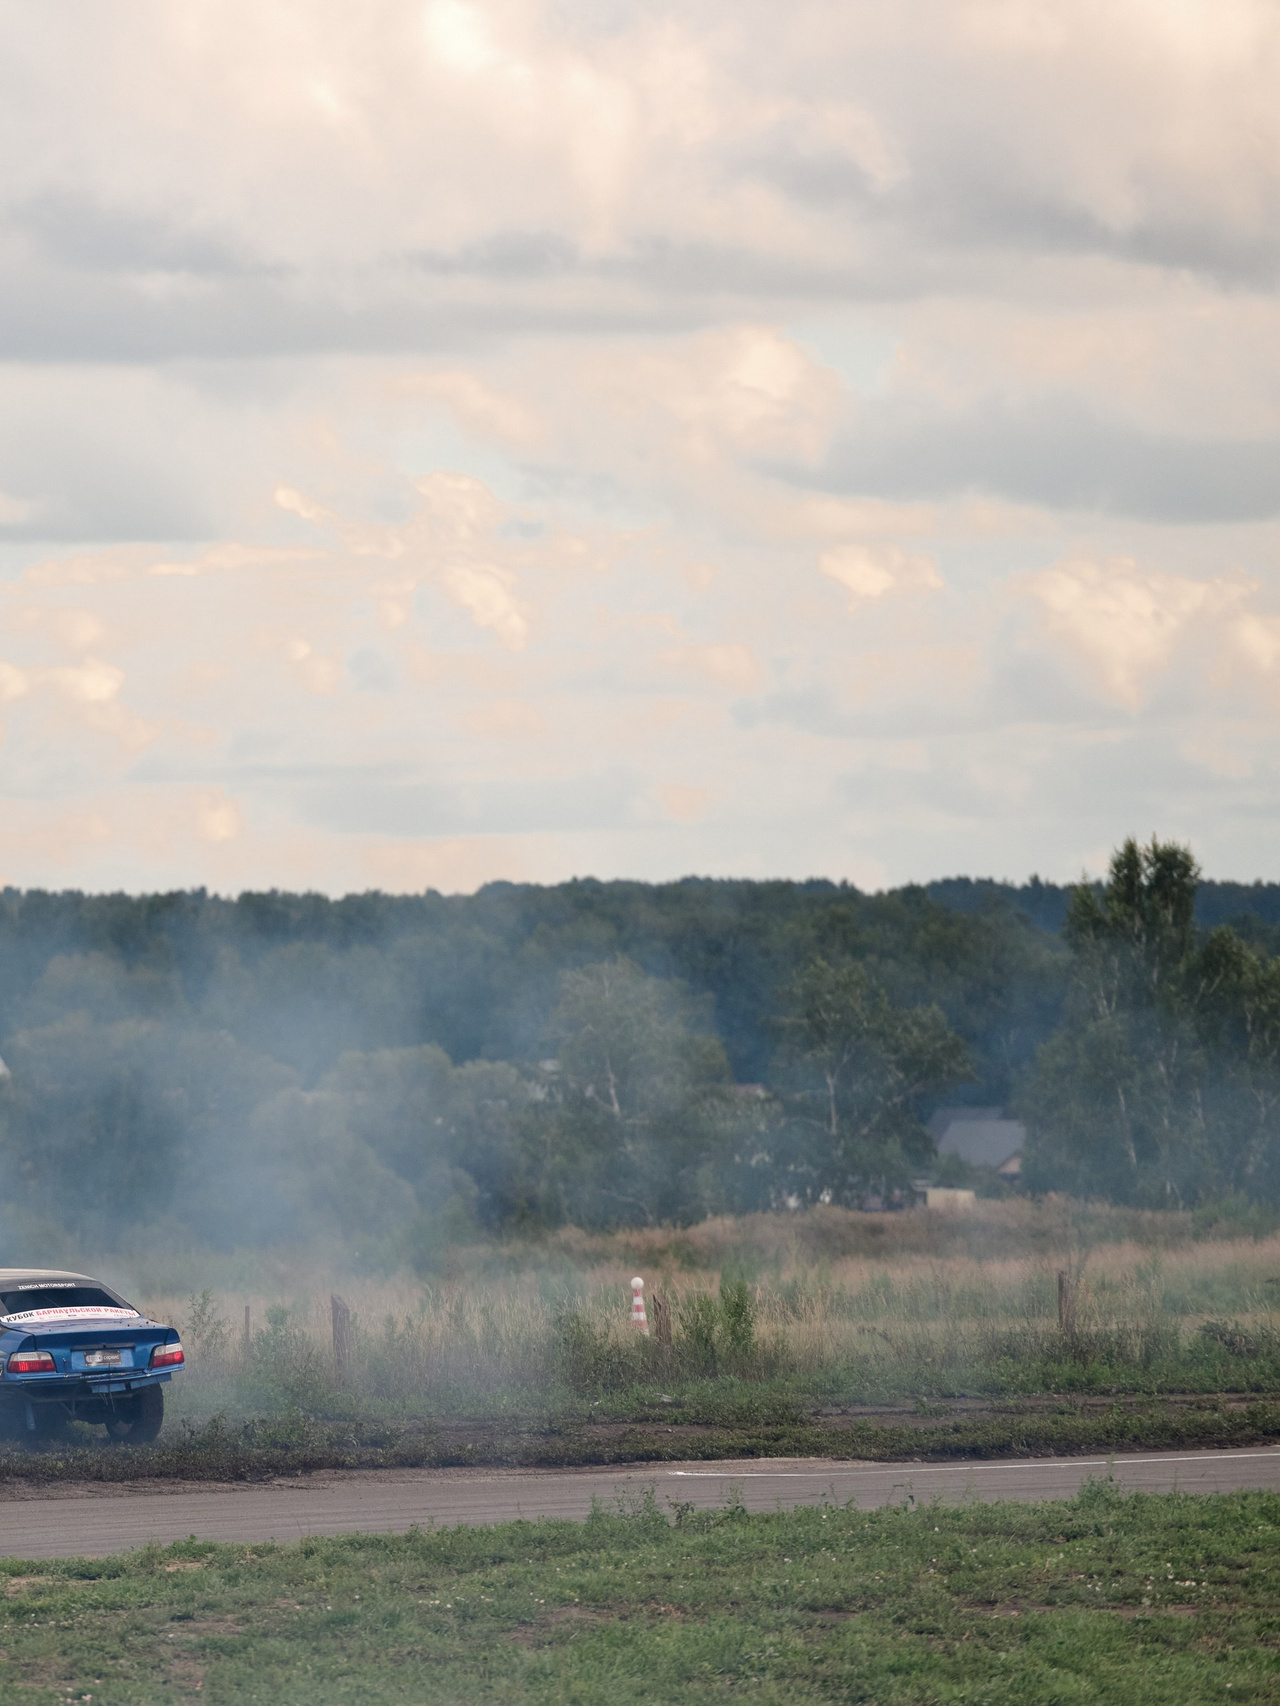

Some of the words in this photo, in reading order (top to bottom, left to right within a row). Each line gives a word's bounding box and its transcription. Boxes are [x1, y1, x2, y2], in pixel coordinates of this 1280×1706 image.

[6, 1312, 35, 1323] КУБОК
[36, 1307, 101, 1316] БАРНАУЛЬСКОЙ
[104, 1308, 137, 1317] РАКЕТЫ
